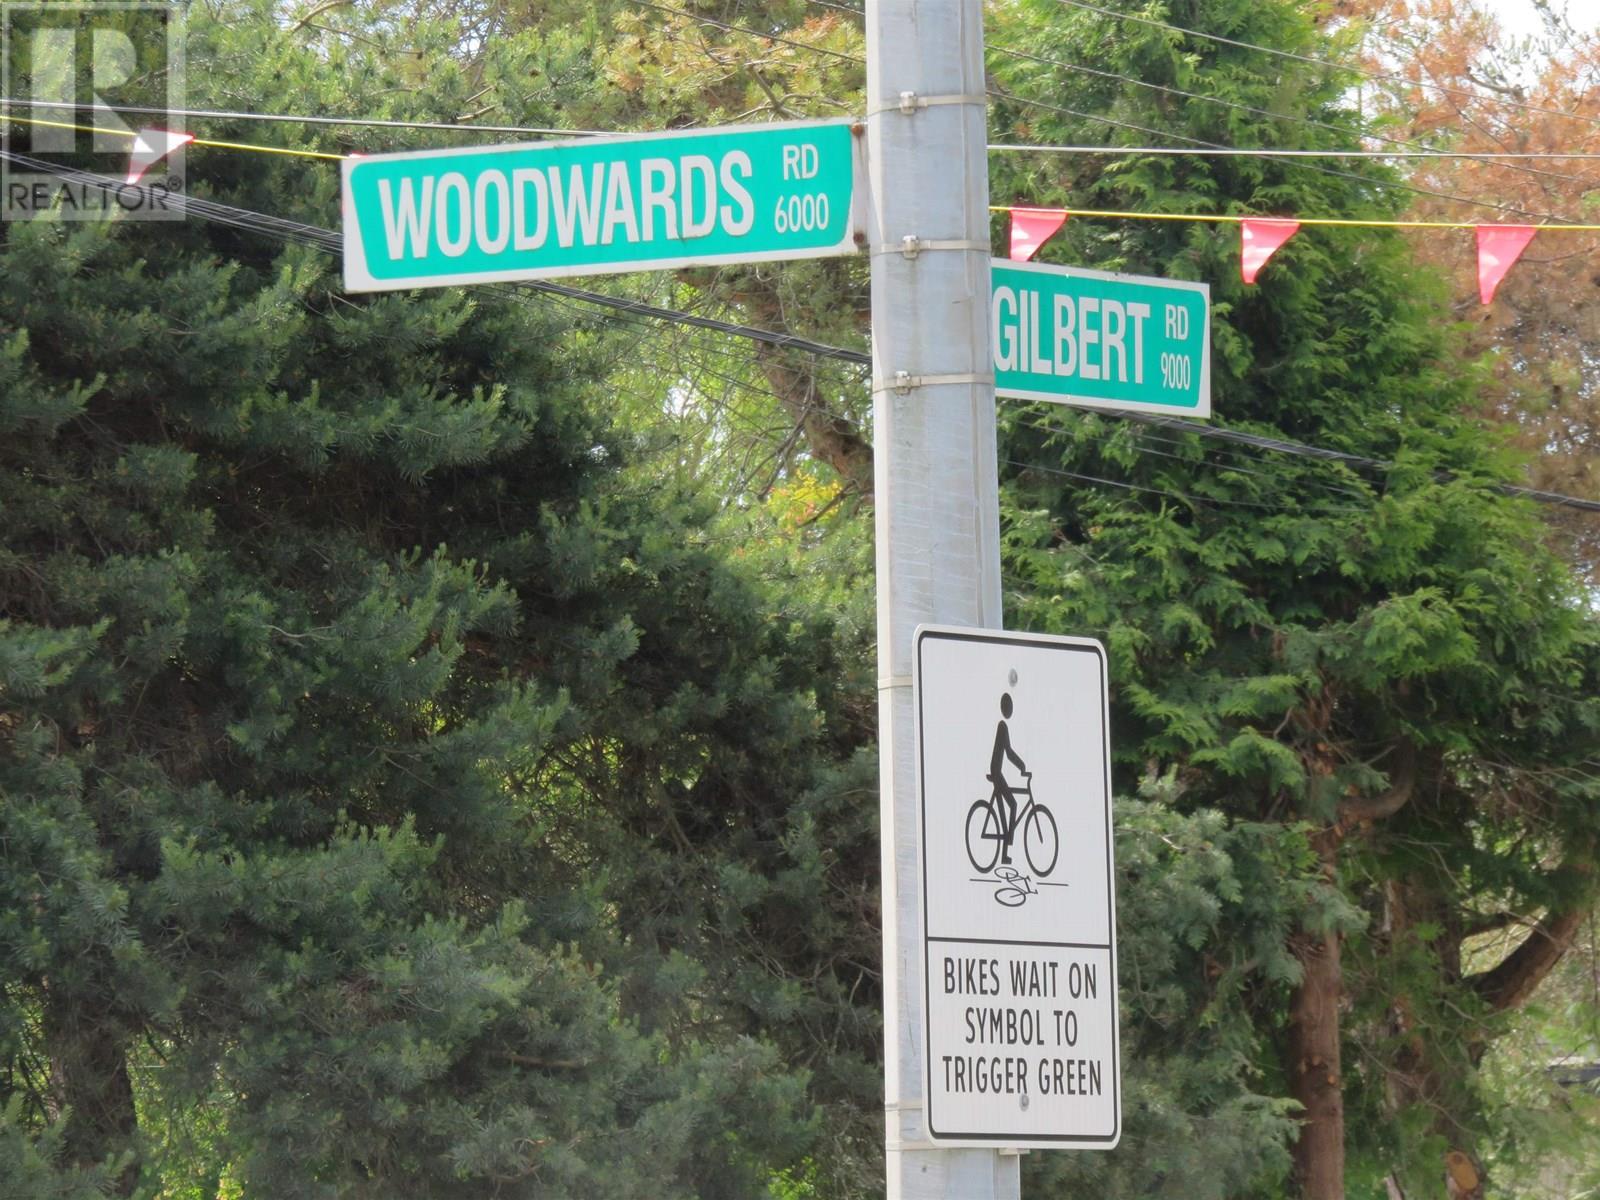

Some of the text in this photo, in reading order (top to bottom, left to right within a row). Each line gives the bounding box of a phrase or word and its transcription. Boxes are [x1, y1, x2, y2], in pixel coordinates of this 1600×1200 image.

[378, 143, 819, 260] WOODWARDS RD
[775, 193, 829, 233] 6000
[993, 286, 1189, 384] GILBERT RD
[1160, 352, 1191, 390] 9000
[944, 957, 1097, 999] BIKES WAIT ON
[965, 1007, 1078, 1047] SYMBOL TO
[942, 1056, 1102, 1096] TRIGGER GREEN
